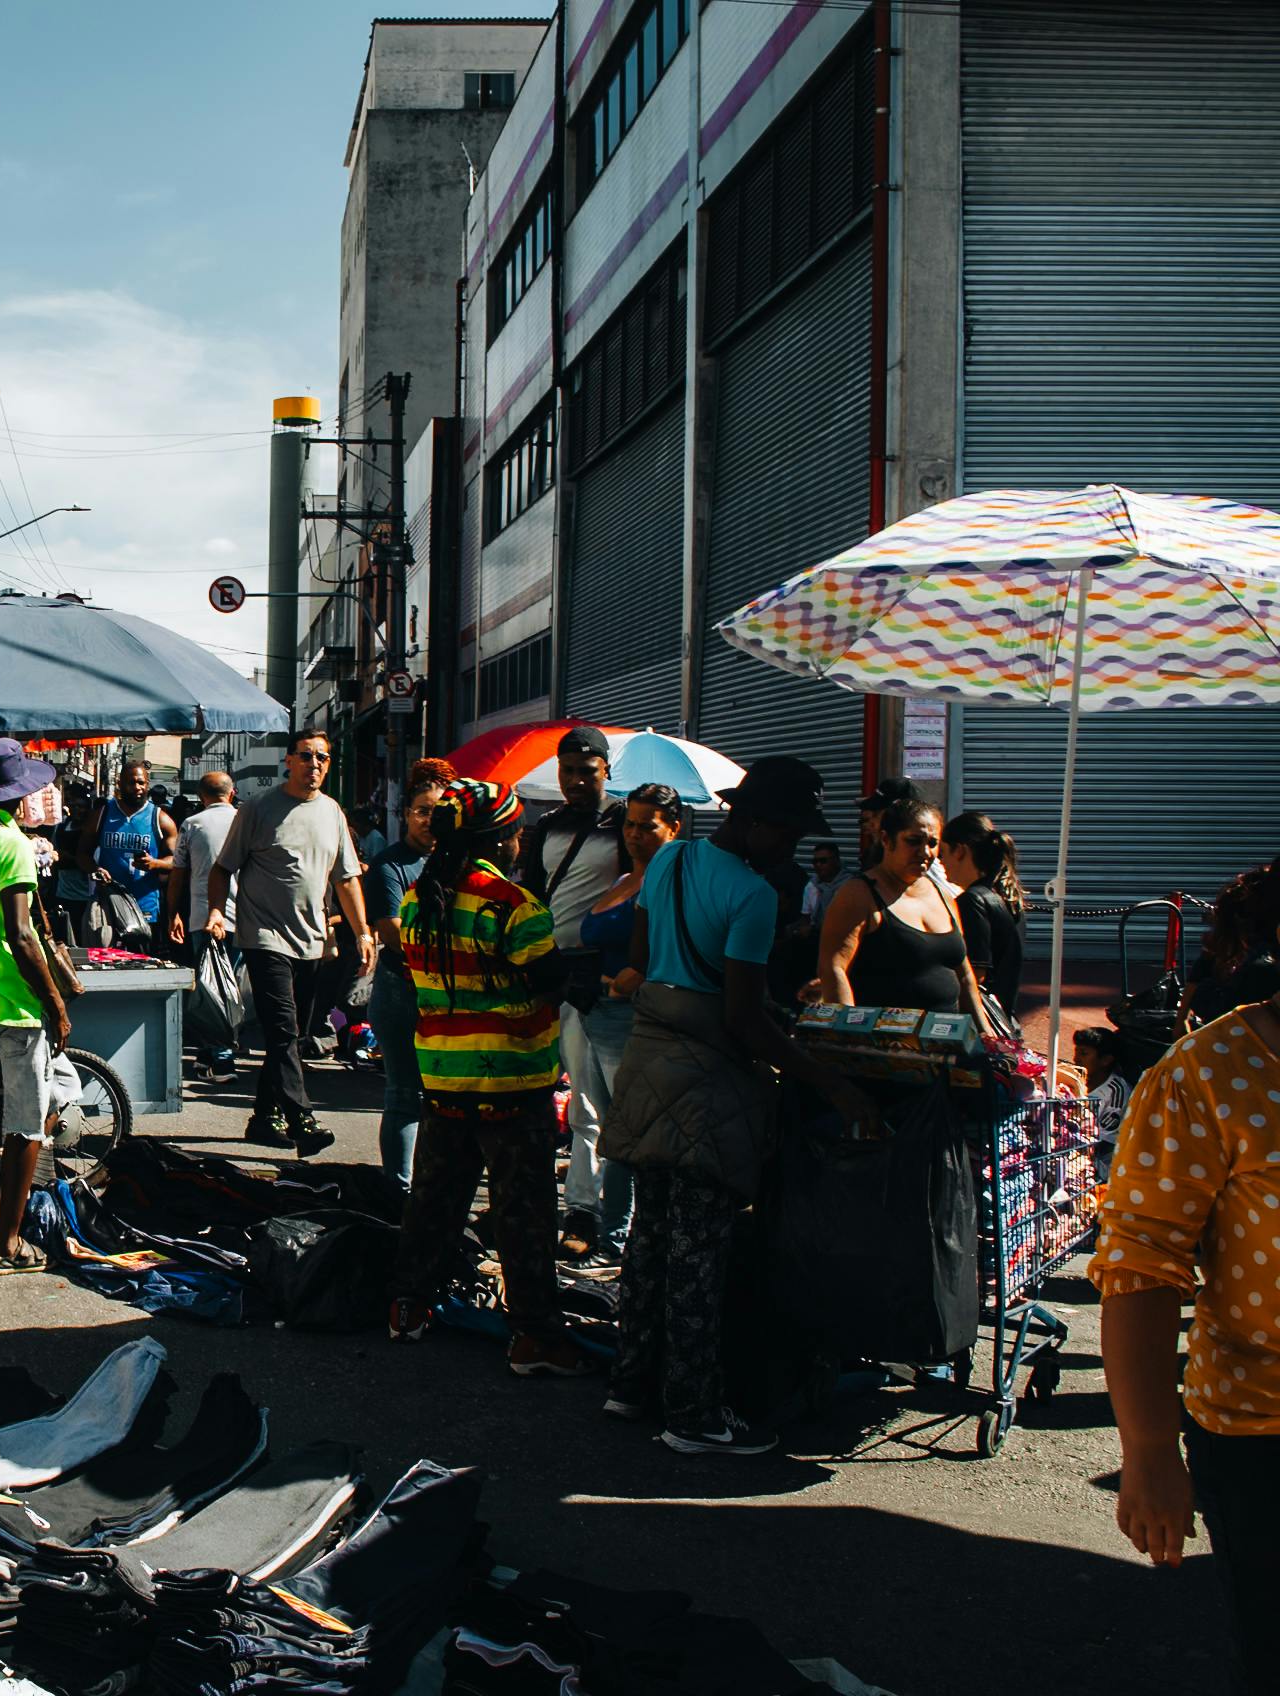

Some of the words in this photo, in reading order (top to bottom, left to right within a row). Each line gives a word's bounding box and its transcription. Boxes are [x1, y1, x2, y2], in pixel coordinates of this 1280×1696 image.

[220, 584, 234, 605] E
[395, 676, 406, 692] E
[257, 777, 272, 787] 300
[104, 831, 151, 850] DALLAS
